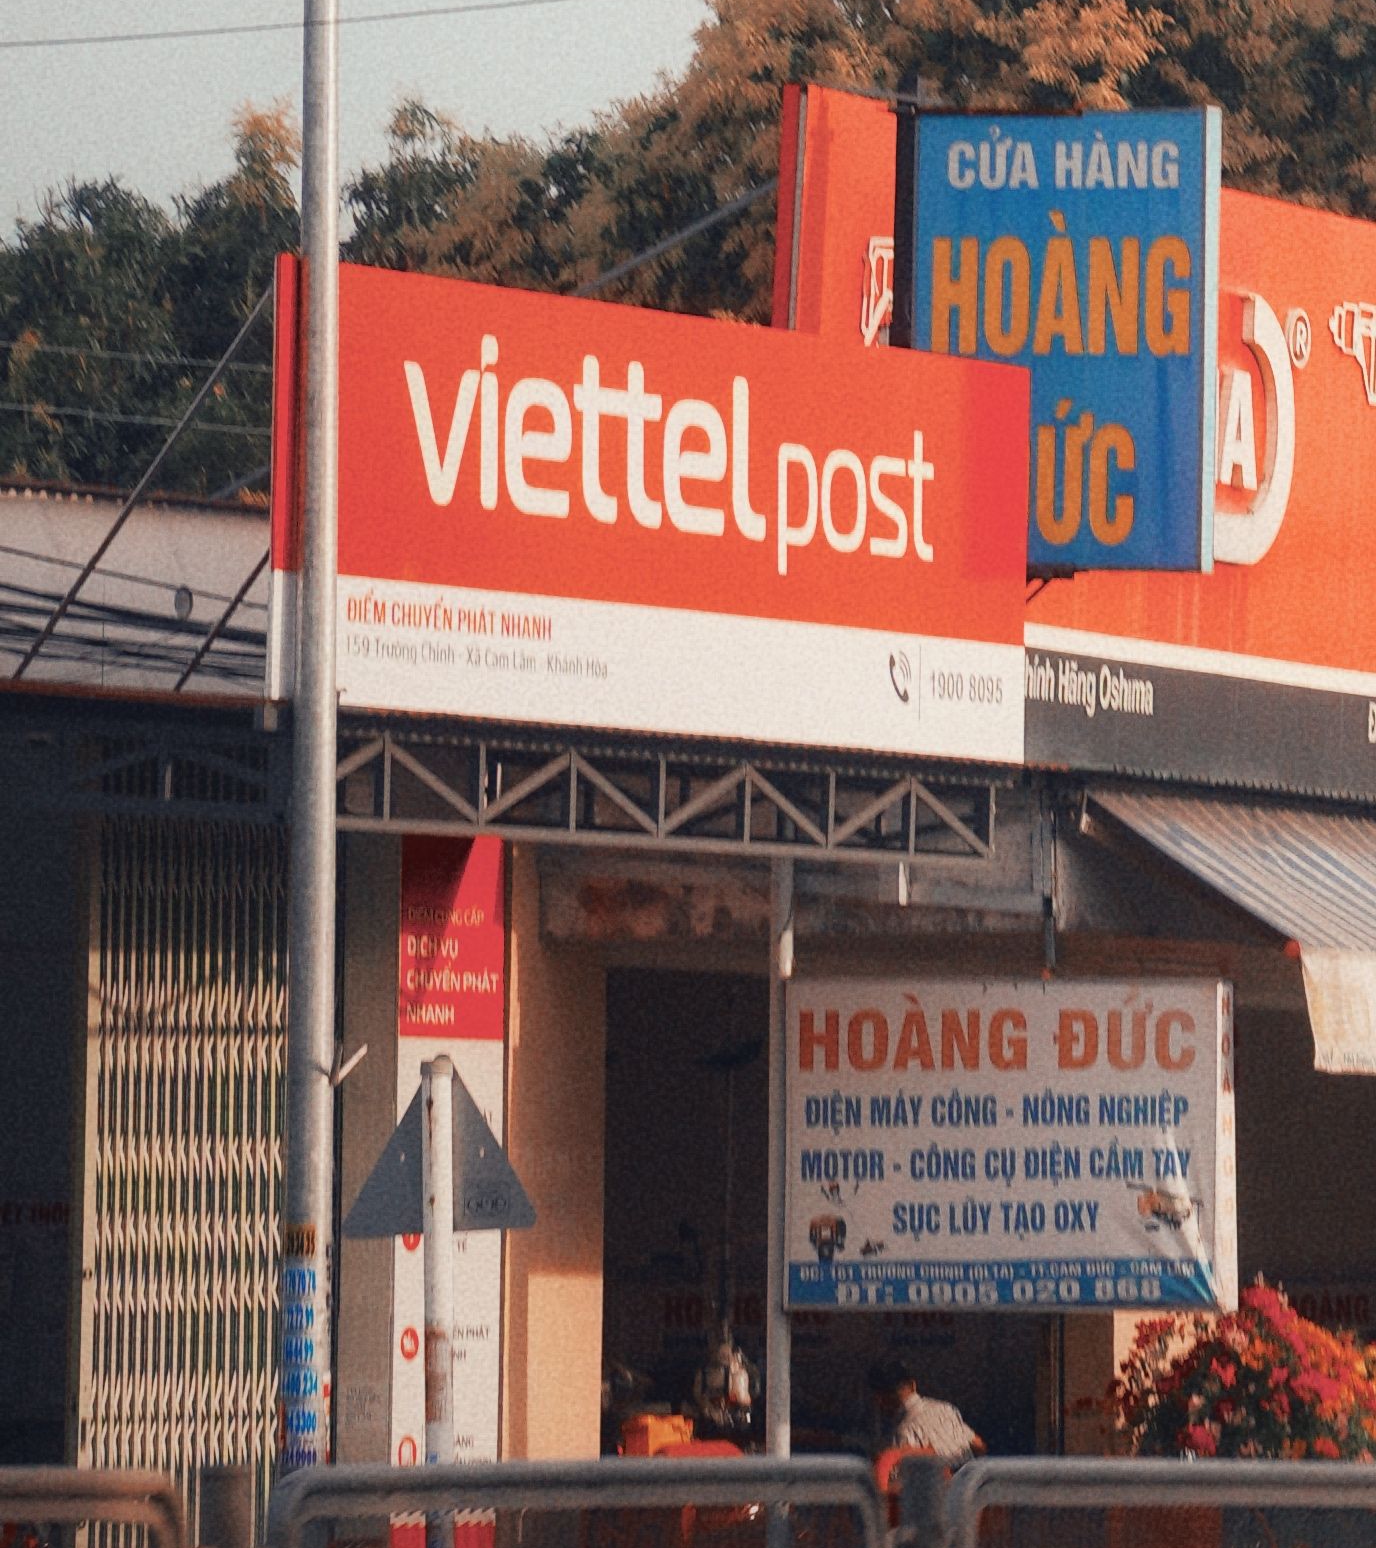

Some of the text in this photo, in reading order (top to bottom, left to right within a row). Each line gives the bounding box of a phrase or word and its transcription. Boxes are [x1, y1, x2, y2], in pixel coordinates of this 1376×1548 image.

[948, 126, 1180, 190] CỬA HÀNG
[931, 209, 1192, 357] HOÀNG
[404, 334, 935, 576] viettel post
[1036, 398, 1136, 546] ỨC
[347, 588, 552, 641] ĐIỂM CHUYỂN PHÁT NHANH
[346, 635, 370, 655] 159
[466, 646, 481, 667] Xã
[484, 650, 509, 670] Cam
[929, 670, 1003, 704] 1900 8095
[1025, 654, 1154, 718] hính Hãng Oshima
[407, 934, 459, 961] DỊCH VỤ
[406, 961, 499, 994] CHUYỂN PHÁT
[406, 1001, 455, 1025] NHANH
[800, 986, 1197, 1073] HOÀNG ĐỨC
[805, 1086, 1190, 1136] ĐIỆN MÁY CÔNG NÔNG NGHIỆP
[801, 1136, 1191, 1188] MOTOR CÔNG CỤ ĐIỆN CẦM TAY
[892, 1202, 941, 1242] SỤC
[1000, 1202, 1045, 1241] TẠO
[1054, 1201, 1100, 1235] OXY
